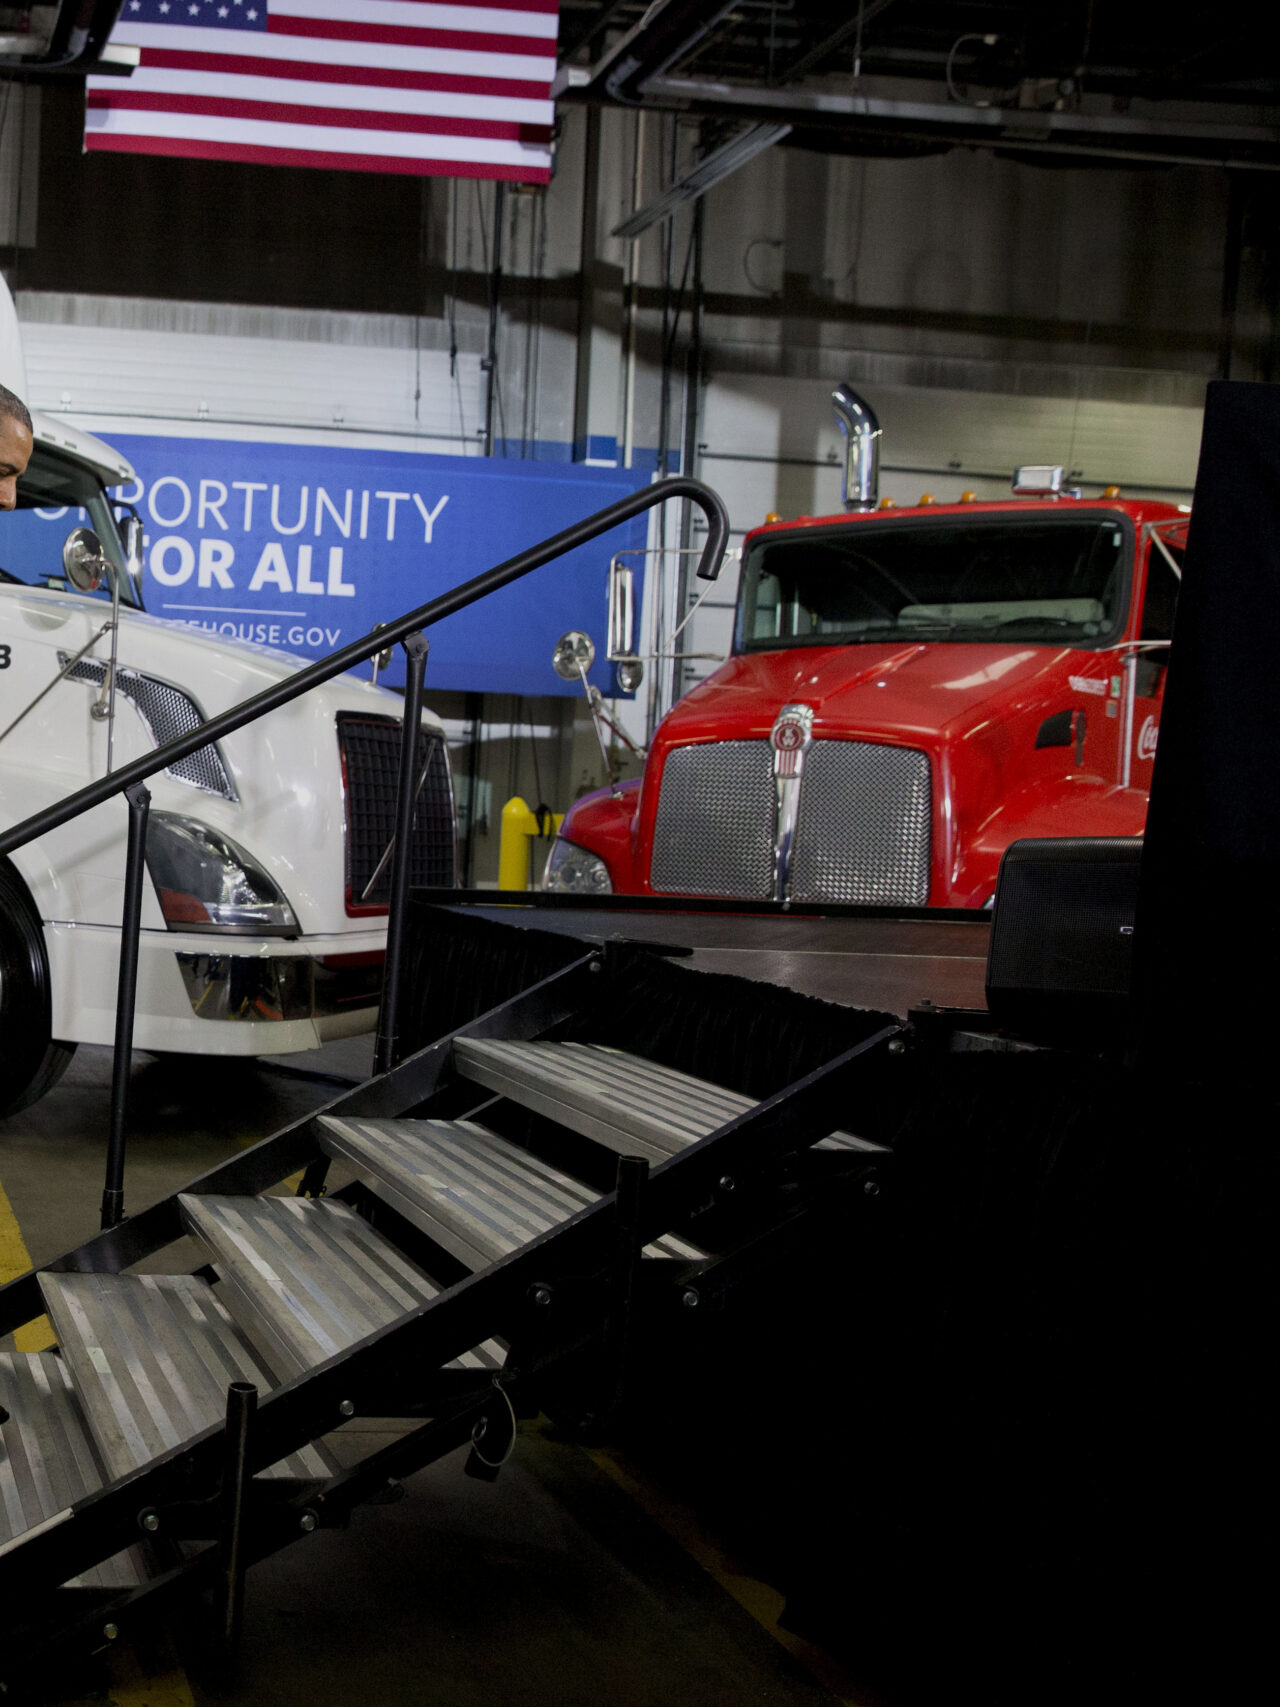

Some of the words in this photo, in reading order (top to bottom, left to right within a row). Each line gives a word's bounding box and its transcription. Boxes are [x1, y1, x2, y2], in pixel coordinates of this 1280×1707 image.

[32, 476, 450, 543] PORTUNITY
[142, 534, 235, 589] OR
[248, 542, 356, 597] ALL
